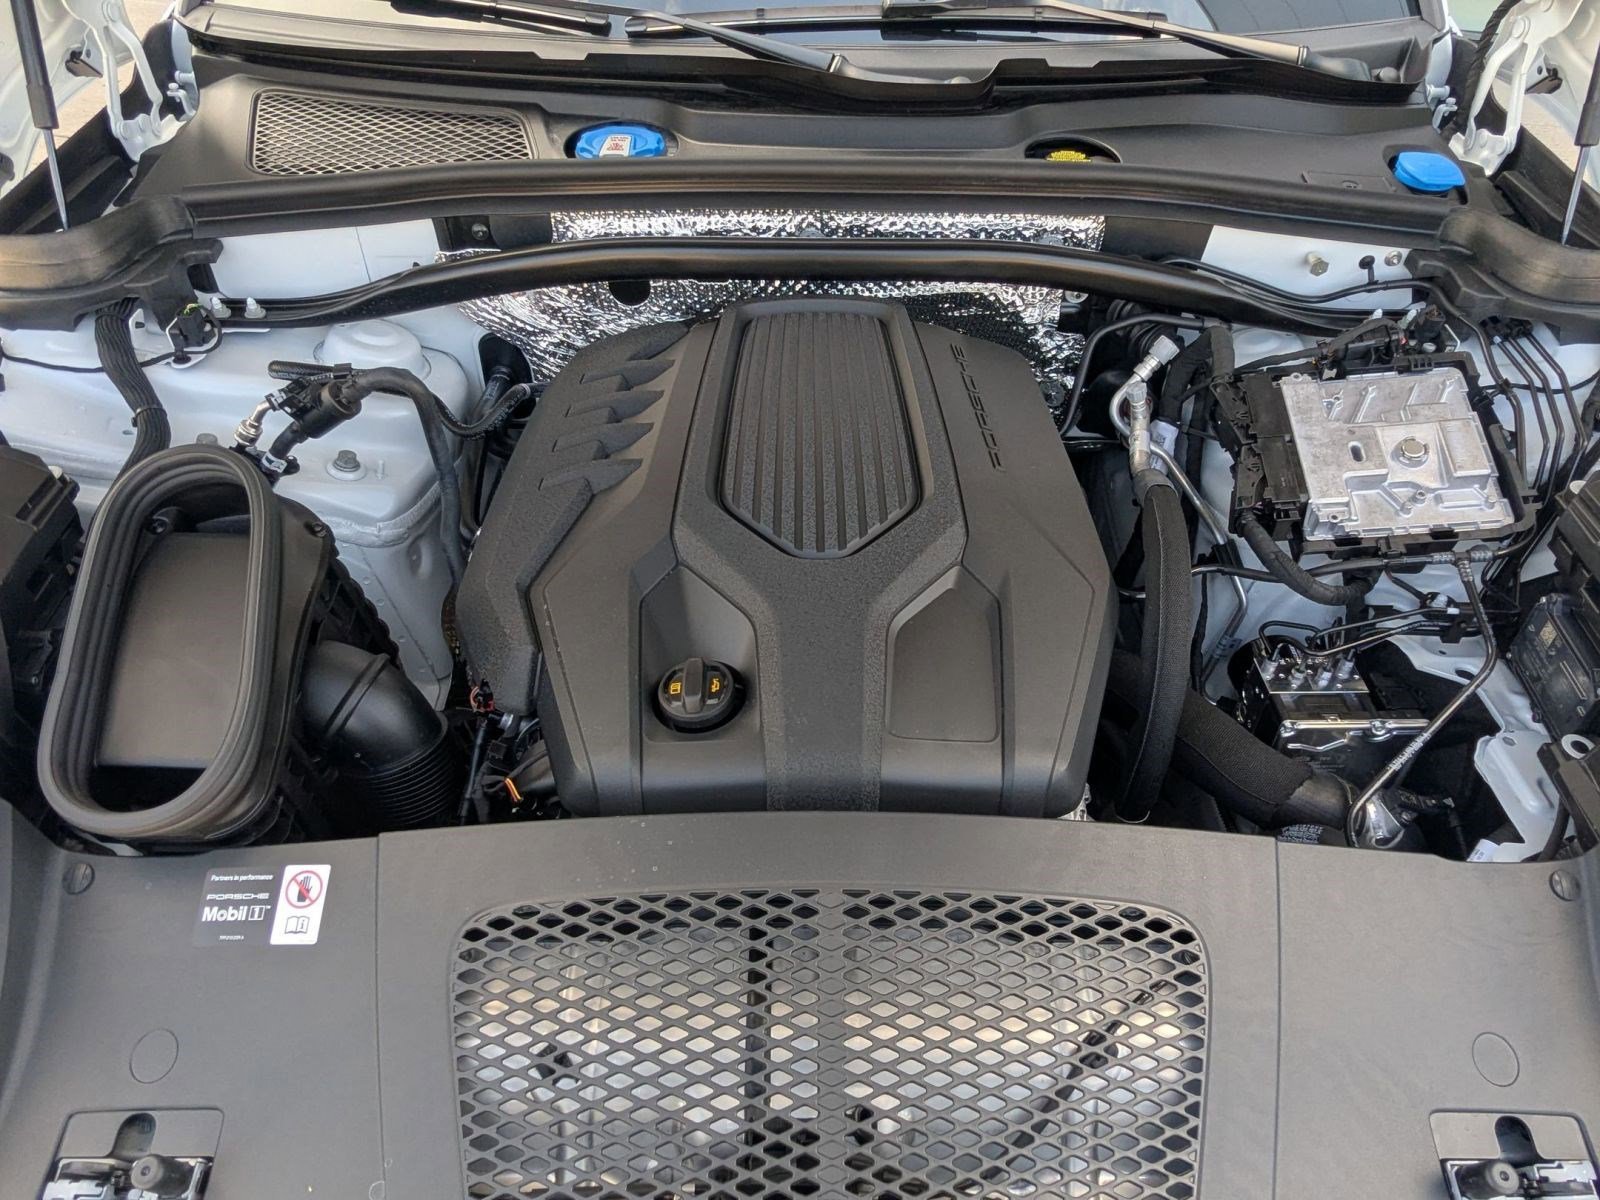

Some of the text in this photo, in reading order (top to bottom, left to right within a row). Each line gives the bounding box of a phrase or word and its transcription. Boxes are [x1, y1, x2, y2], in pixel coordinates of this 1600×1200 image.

[950, 343, 1003, 470] PORSCHE
[239, 874, 273, 882] performance
[206, 892, 269, 900] PORSCHE
[202, 905, 248, 921] Mobil
